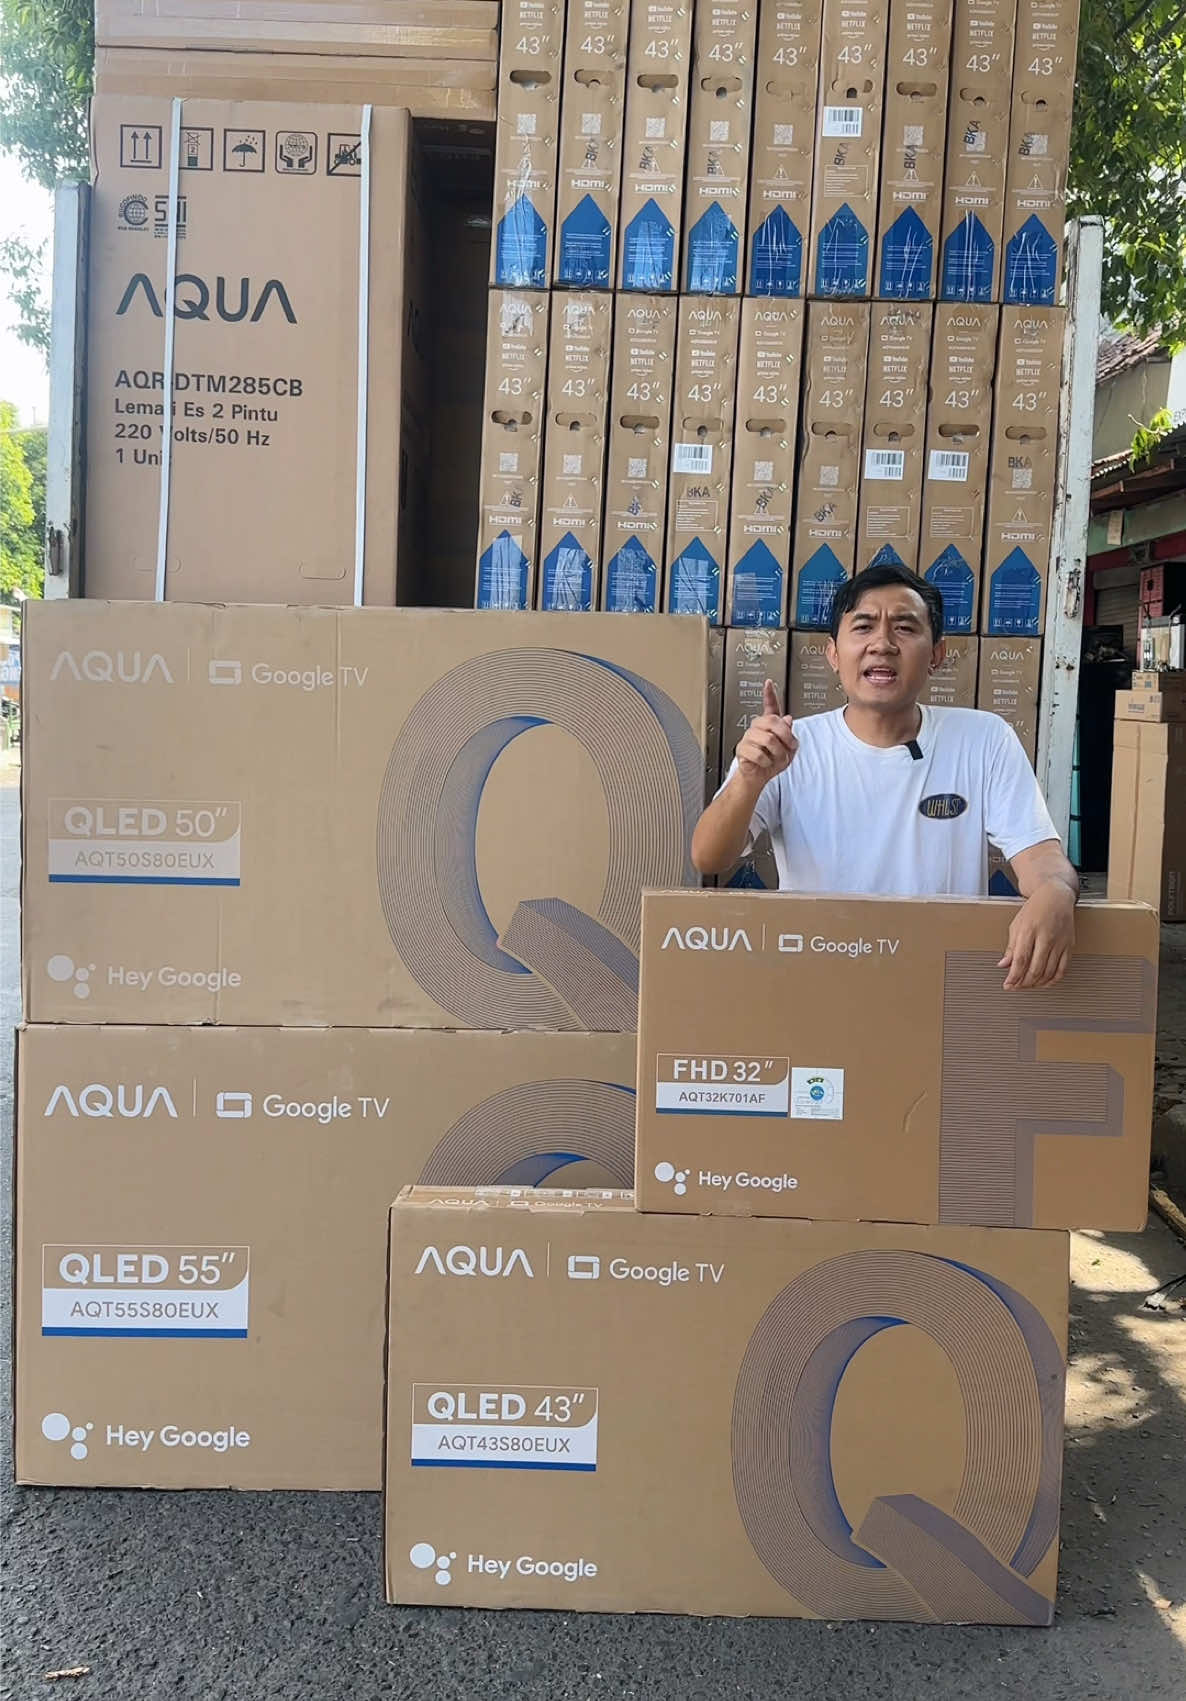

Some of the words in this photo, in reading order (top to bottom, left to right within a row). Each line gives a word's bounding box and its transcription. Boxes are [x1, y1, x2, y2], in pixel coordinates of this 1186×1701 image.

[516, 35, 550, 54] 43"
[580, 33, 616, 54] 43"
[644, 38, 680, 58] 43"
[708, 42, 744, 62] 43"
[837, 43, 872, 64] 43"
[773, 46, 807, 66] 43"
[902, 47, 937, 66] 43"
[966, 53, 1000, 72] 43"
[1028, 56, 1063, 75] 43"
[963, 120, 981, 144] BKA
[904, 145, 917, 169] BKA
[115, 273, 298, 324] AQUA
[627, 309, 661, 319] AQUA
[688, 311, 722, 321] AQUA
[754, 311, 788, 321] AQUA
[821, 316, 854, 326] AQUA
[946, 317, 981, 327] AQUA
[1014, 319, 1048, 329] AQUA
[114, 369, 304, 397] AQRDTM285CB
[498, 377, 532, 395] 43"
[562, 378, 595, 397] 43"
[626, 382, 661, 400] 43"
[687, 383, 721, 402] 43"
[753, 384, 787, 403] 43"
[819, 389, 854, 408] 43"
[879, 388, 914, 408] 43"
[944, 389, 979, 409] 43"
[1012, 391, 1047, 411] 43"
[114, 398, 177, 417] Lemai
[184, 401, 205, 418] Es
[212, 403, 224, 419] 2
[231, 403, 279, 422] Pintu
[114, 423, 152, 440] 220
[159, 425, 239, 446] olts/50
[247, 430, 271, 447] Hz
[115, 447, 125, 464] 1
[133, 449, 172, 466] Uni
[1008, 456, 1031, 468] BKA
[687, 486, 710, 498] BKA
[800, 646, 827, 655] AQU
[990, 650, 1024, 660] AQUA
[49, 651, 176, 685] AQUA
[251, 663, 336, 692] Google
[338, 667, 369, 687] TV
[64, 807, 168, 838] QLED
[175, 807, 228, 838] 50"
[74, 850, 216, 869] AQT50S80EUX
[661, 927, 753, 951] AQUA
[810, 936, 873, 958] Google
[876, 938, 900, 955] TV
[108, 966, 153, 990] Hey
[158, 967, 242, 992] Google
[673, 1059, 728, 1081] FHD
[733, 1060, 774, 1082] 32"
[44, 1084, 178, 1119] AQUA
[262, 1094, 351, 1124] Google
[358, 1096, 391, 1118] TV
[679, 1091, 766, 1104] AQT32K701AF
[699, 1171, 733, 1191] Hey
[735, 1172, 798, 1192] Google
[59, 1252, 169, 1284] QLED
[178, 1252, 236, 1284] 55"
[414, 1245, 535, 1279] AQUA
[609, 1258, 690, 1286] Google
[696, 1263, 726, 1284] TV
[70, 1301, 220, 1319] AQT55S80EUX
[427, 1391, 527, 1422] QLED
[534, 1392, 585, 1423] 43"
[106, 1425, 154, 1450] Hey
[160, 1425, 251, 1452] Google
[438, 1434, 571, 1453] AQT43S80EUX
[467, 1554, 512, 1579] Hey
[516, 1556, 598, 1582] Google
